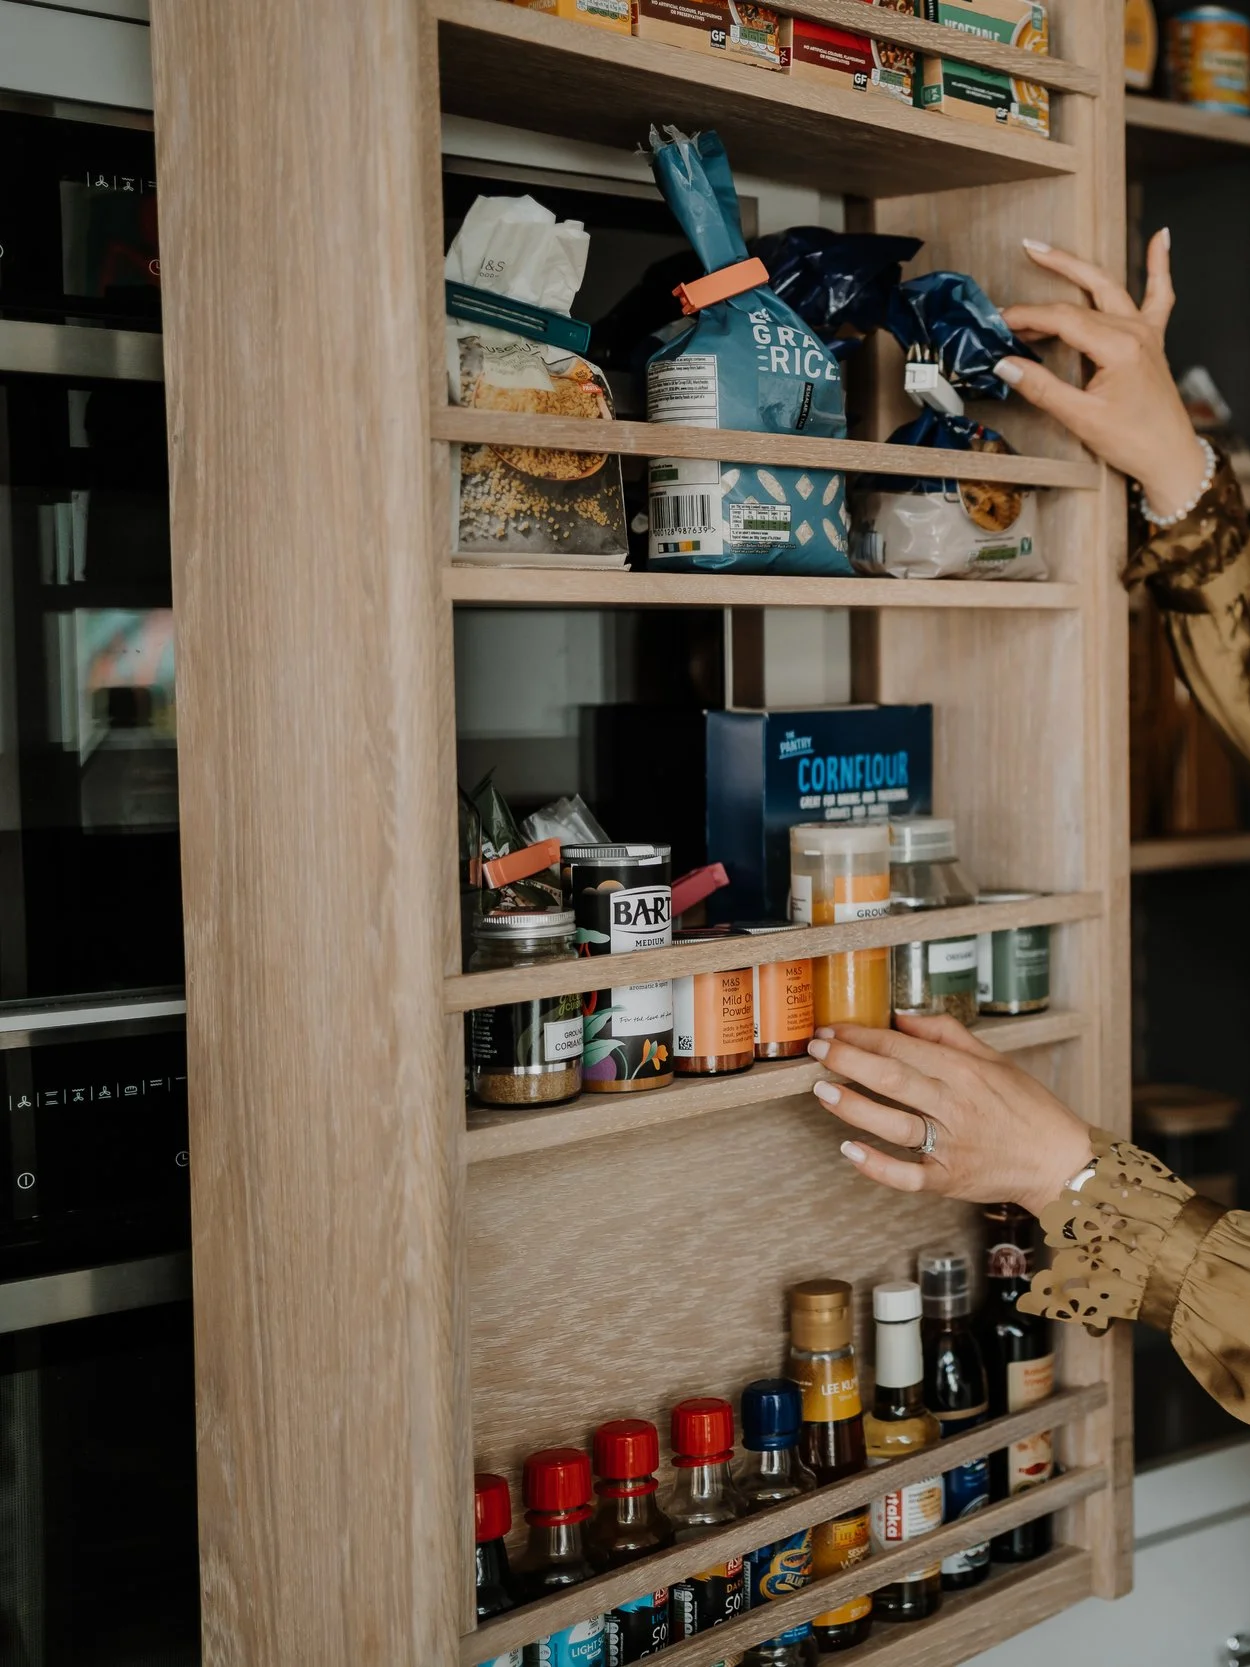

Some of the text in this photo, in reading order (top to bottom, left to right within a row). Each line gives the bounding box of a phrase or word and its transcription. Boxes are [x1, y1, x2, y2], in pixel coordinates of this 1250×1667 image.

[711, 29, 726, 42] GF
[854, 72, 868, 85] GF
[480, 257, 506, 272] &S
[752, 324, 821, 351] GRA
[779, 736, 812, 754] PANTRY
[798, 750, 909, 793] CORNFLOUR
[612, 896, 671, 926] BART
[635, 937, 665, 947] MEDIUM
[786, 966, 803, 976] M&S
[629, 983, 655, 991] aromatic
[722, 978, 740, 988] M&S
[722, 994, 742, 1006] Mild
[786, 994, 806, 1005] Chilli
[821, 1382, 840, 1396] LEE
[572, 1640, 598, 1658] LIGHT
